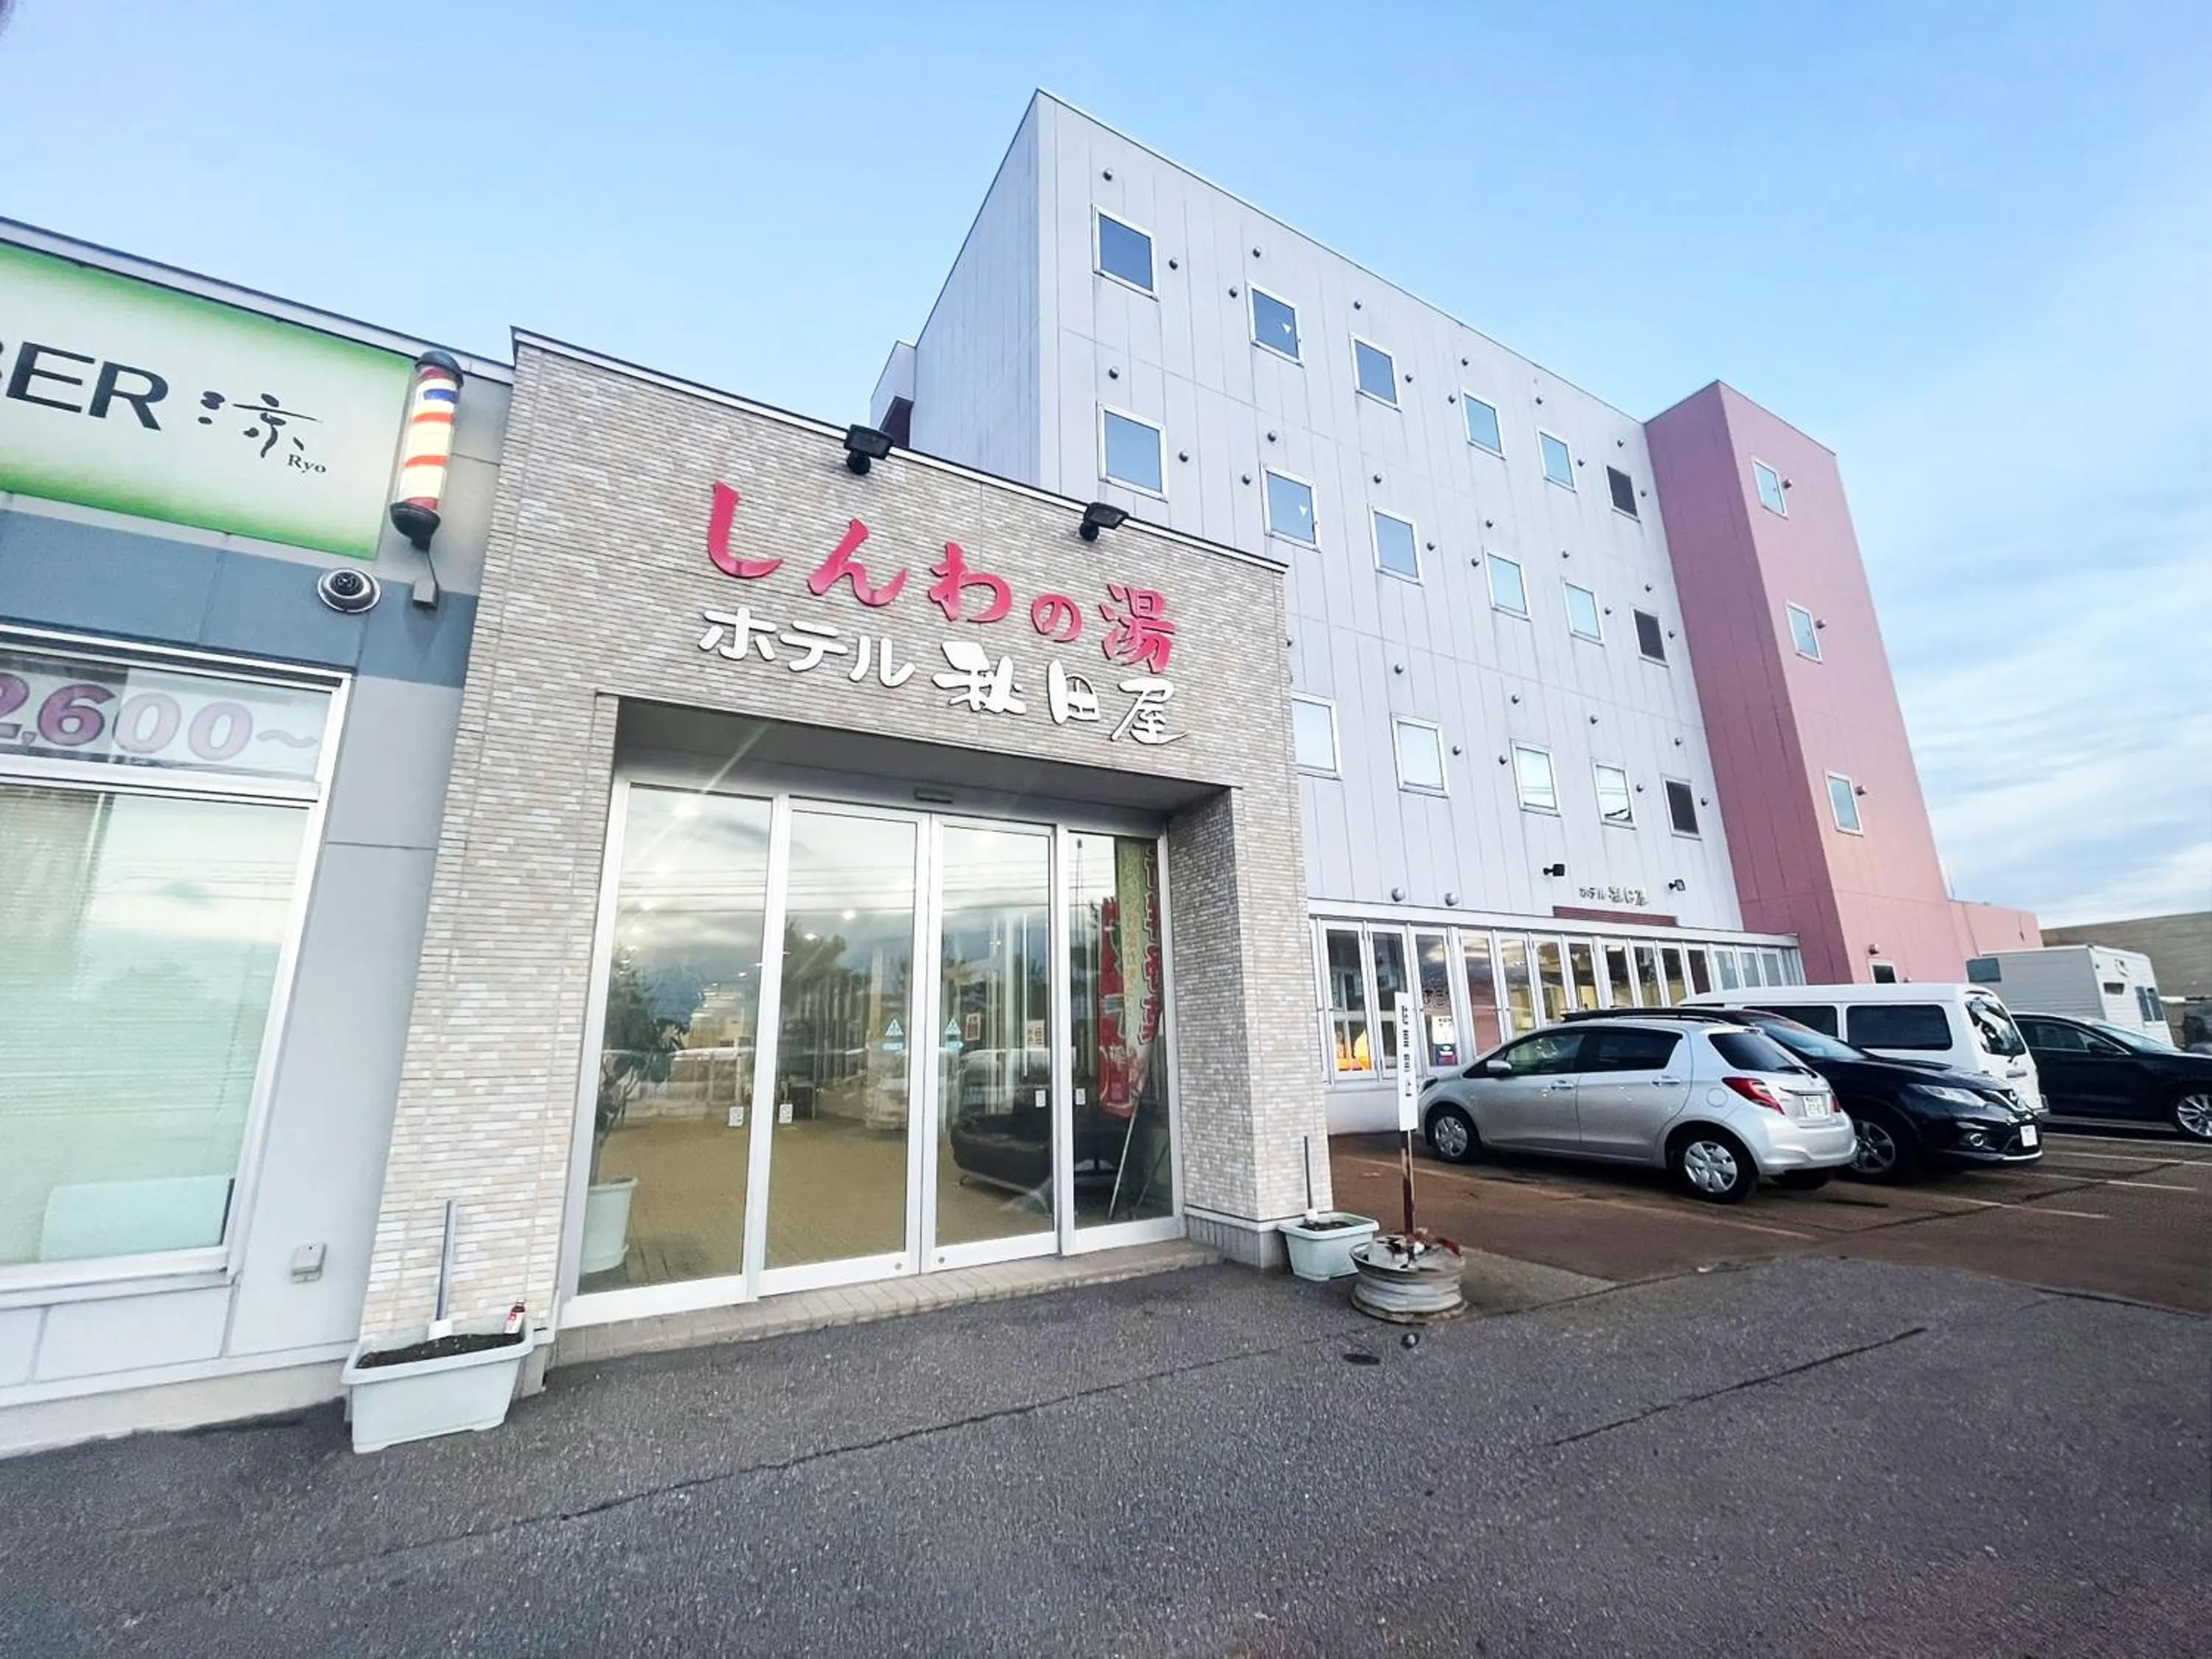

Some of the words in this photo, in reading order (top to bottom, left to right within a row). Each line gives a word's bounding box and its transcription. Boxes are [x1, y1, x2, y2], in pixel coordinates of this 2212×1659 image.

[0, 340, 169, 431] ER
[286, 453, 327, 474] Ryo
[706, 480, 1176, 674] しんわの湯
